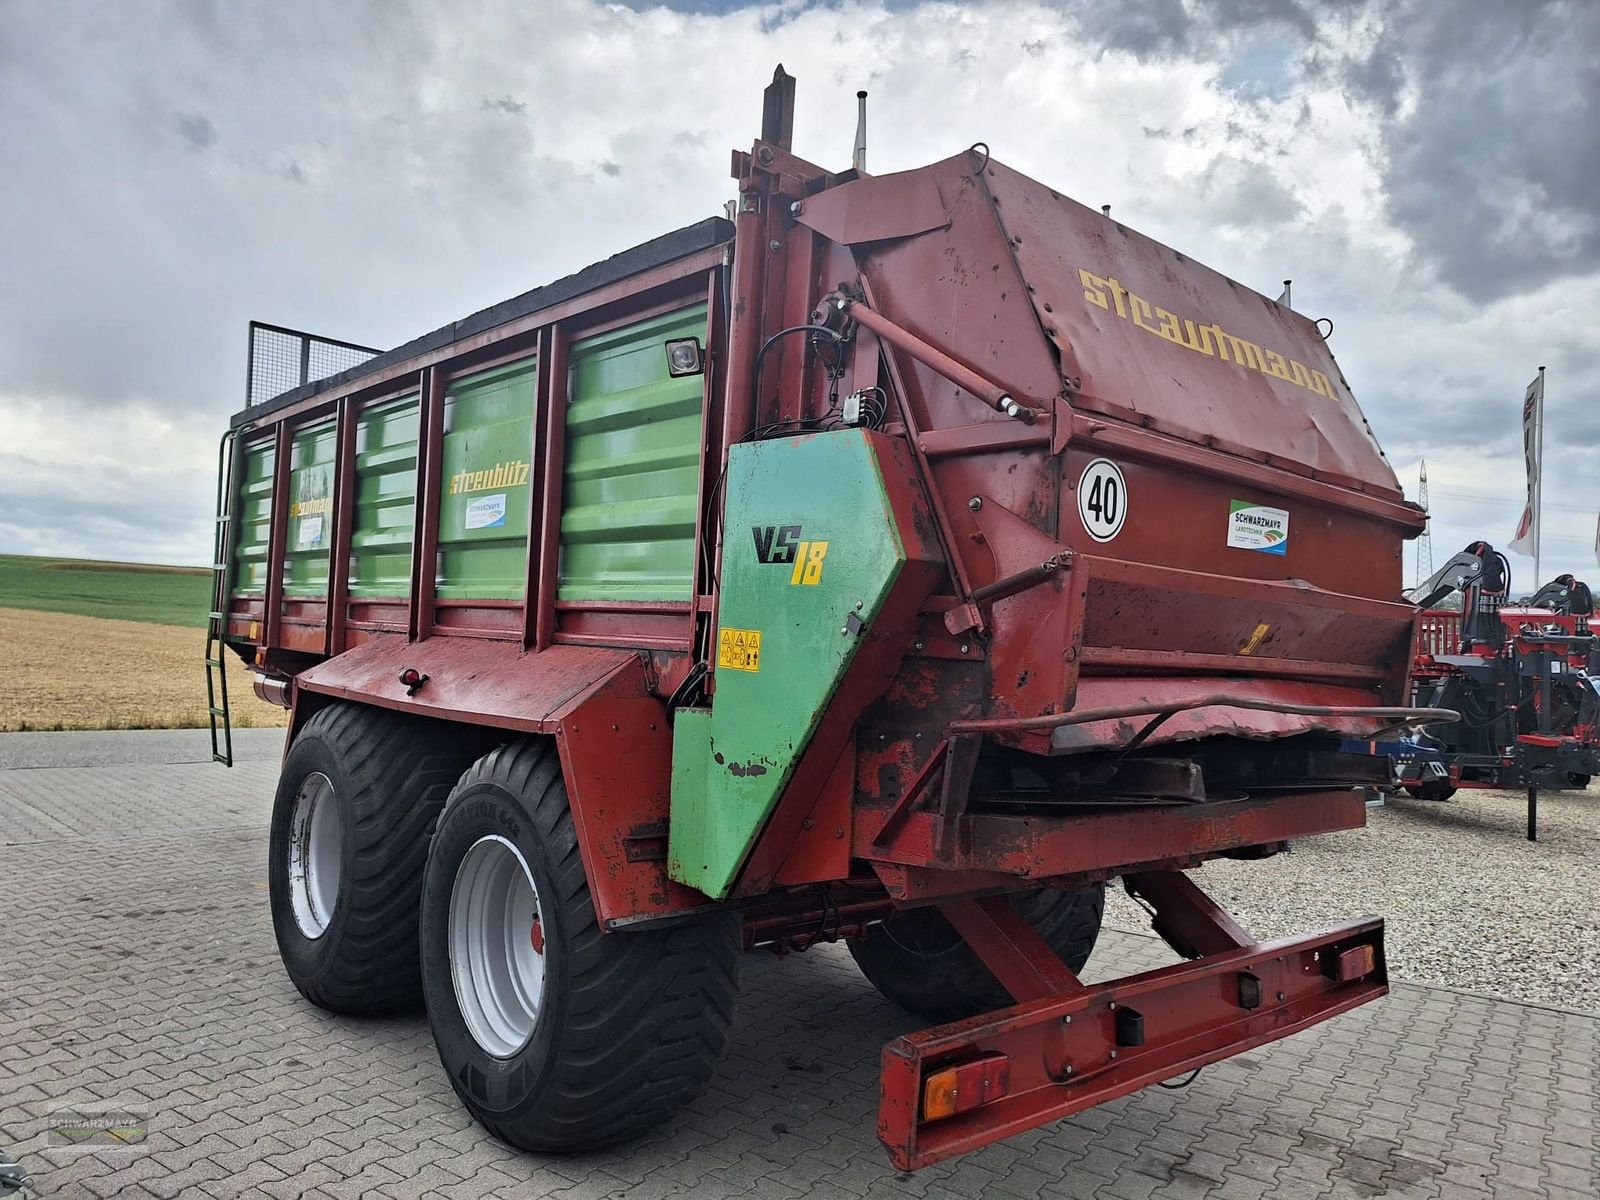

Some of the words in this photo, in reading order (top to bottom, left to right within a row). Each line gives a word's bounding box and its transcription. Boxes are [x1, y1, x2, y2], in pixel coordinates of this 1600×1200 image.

[1077, 268, 1339, 401] strautmann
[450, 460, 531, 495] streublitz
[1088, 475, 1117, 525] 40
[1235, 512, 1281, 529] SCHWARZMAYR
[752, 525, 802, 564] VS
[791, 541, 829, 585] 18
